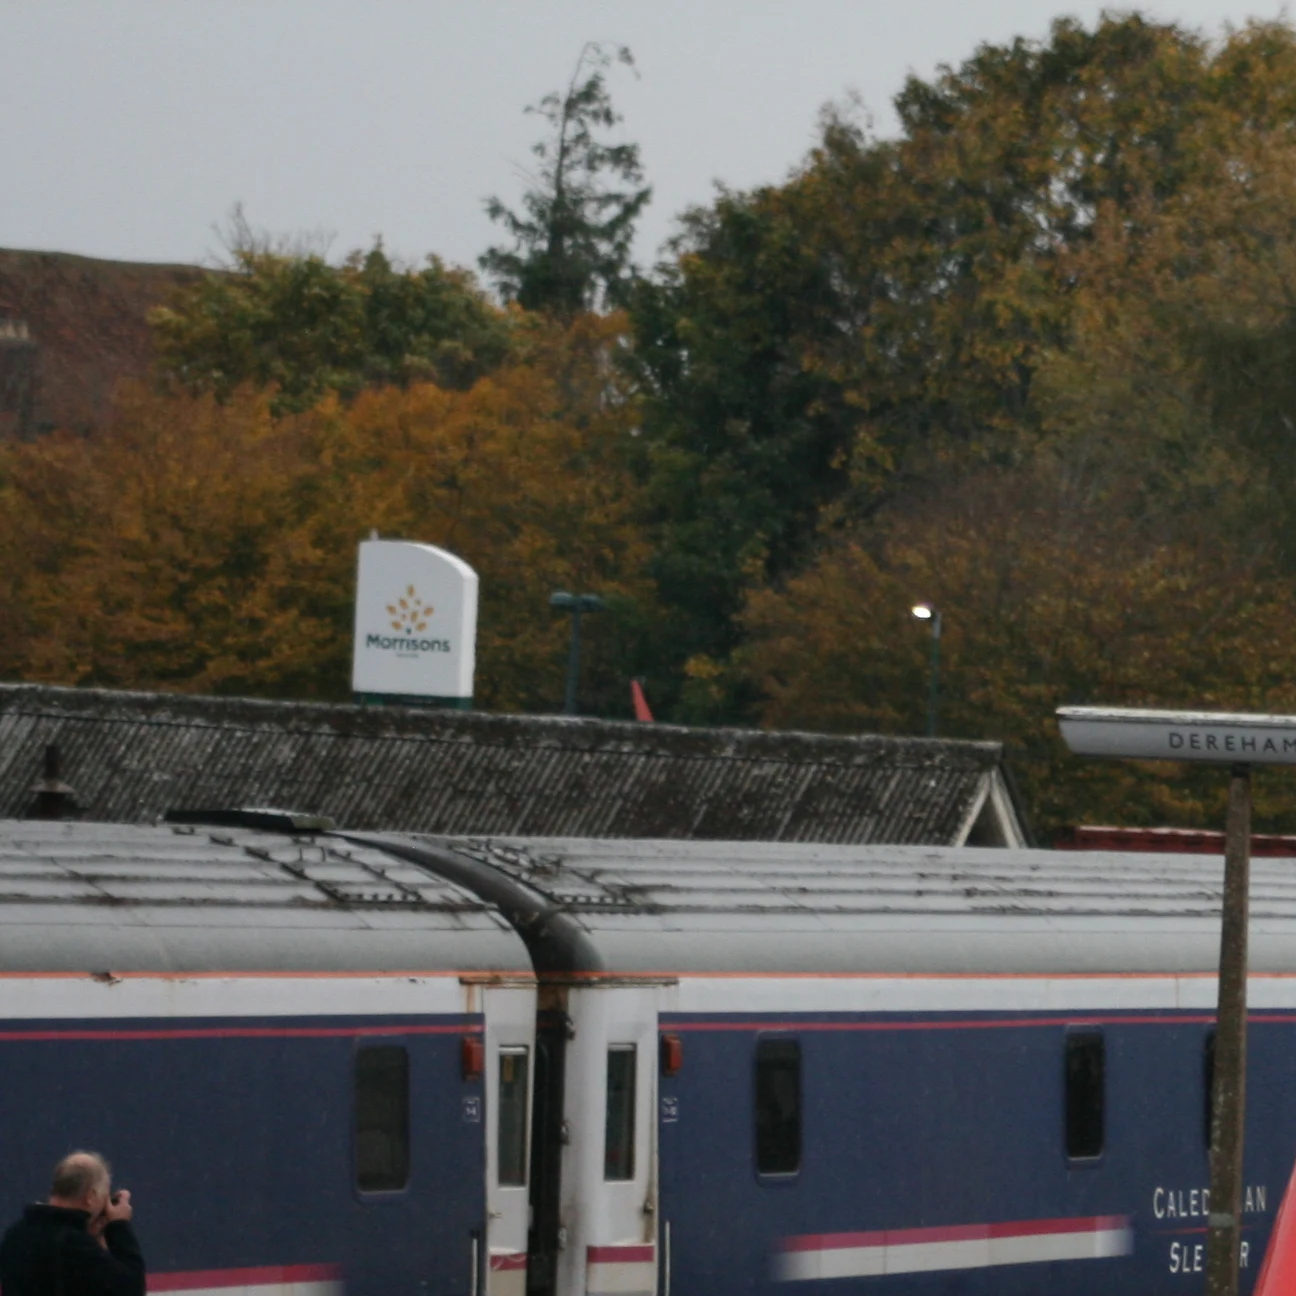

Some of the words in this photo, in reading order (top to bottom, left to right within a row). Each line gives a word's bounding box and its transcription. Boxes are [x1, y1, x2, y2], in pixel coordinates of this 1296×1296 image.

[366, 633, 450, 652] Morrisons
[1153, 1186, 1267, 1219] CALEDAN
[1169, 1241, 1249, 1273] SLER
